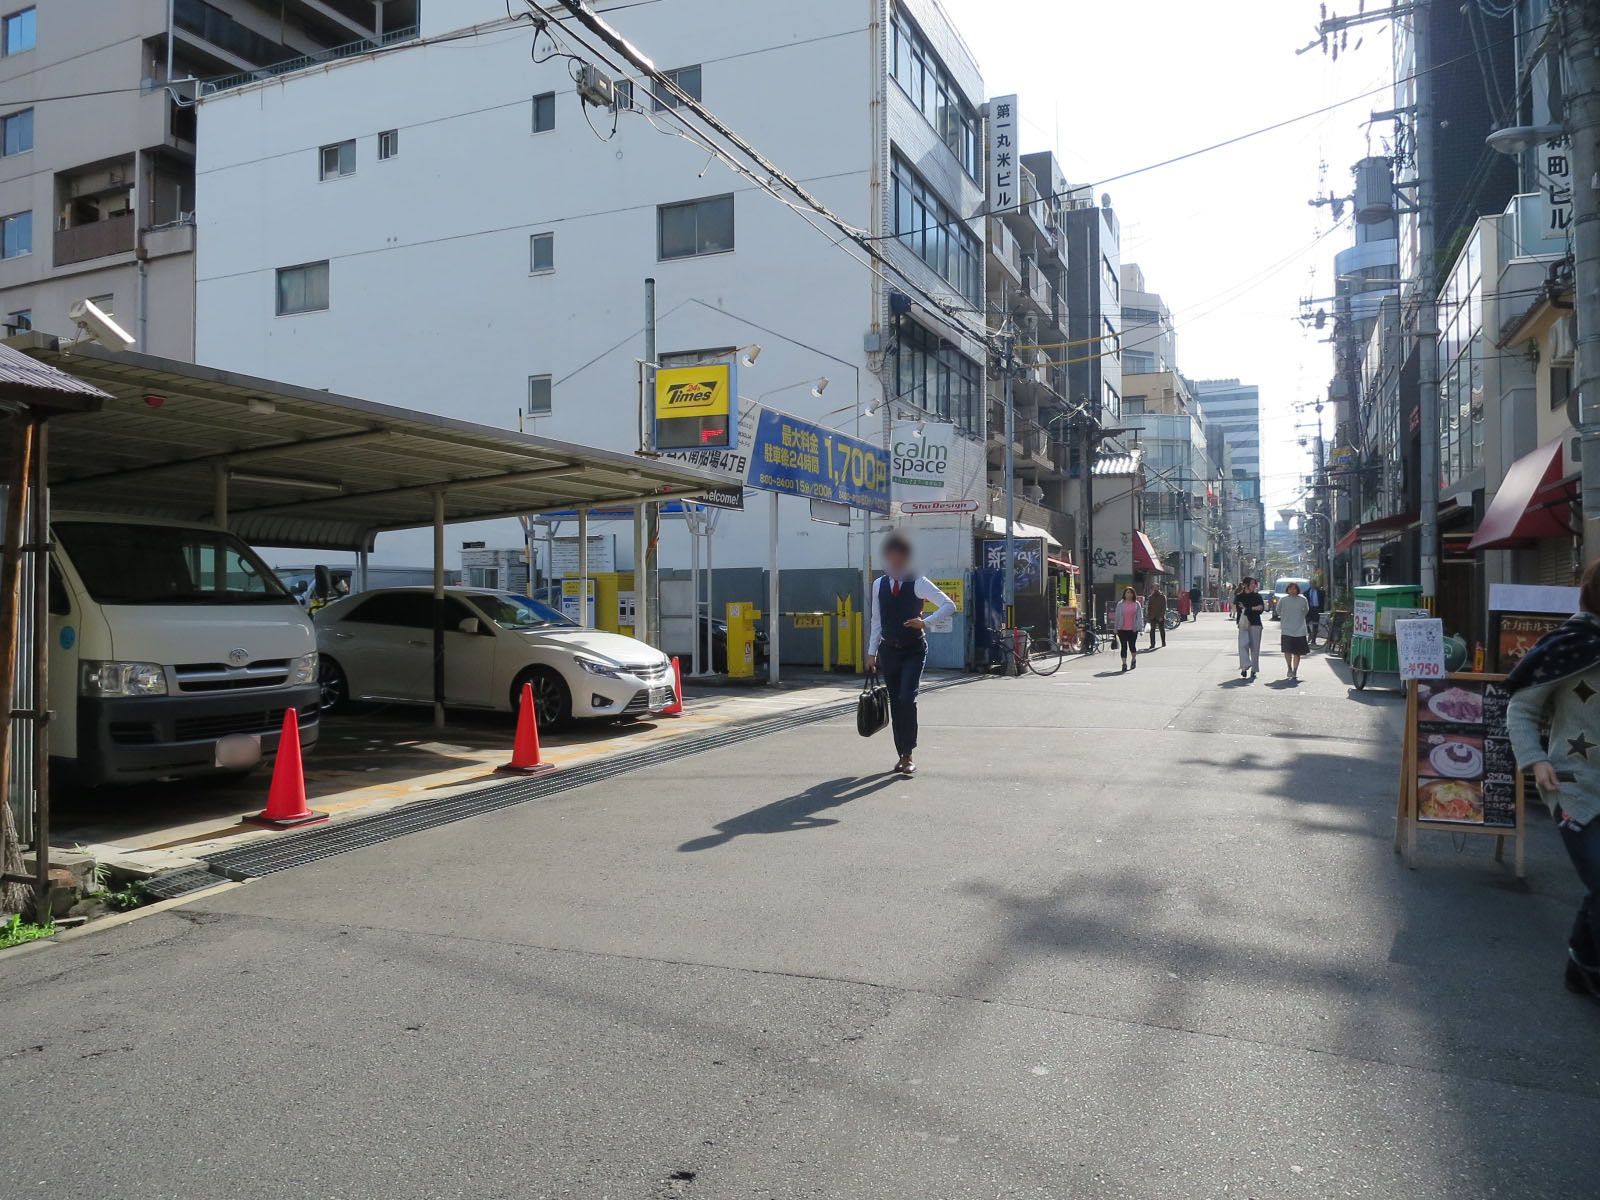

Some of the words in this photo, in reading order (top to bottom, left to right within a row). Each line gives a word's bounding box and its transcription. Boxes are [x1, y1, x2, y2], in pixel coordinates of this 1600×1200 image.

[996, 104, 1011, 207] 第一丸米ビル
[668, 390, 712, 404] Times
[782, 424, 819, 454] 最大料金
[893, 436, 948, 460] calm
[824, 438, 887, 494] 1,700円
[893, 457, 946, 476] space
